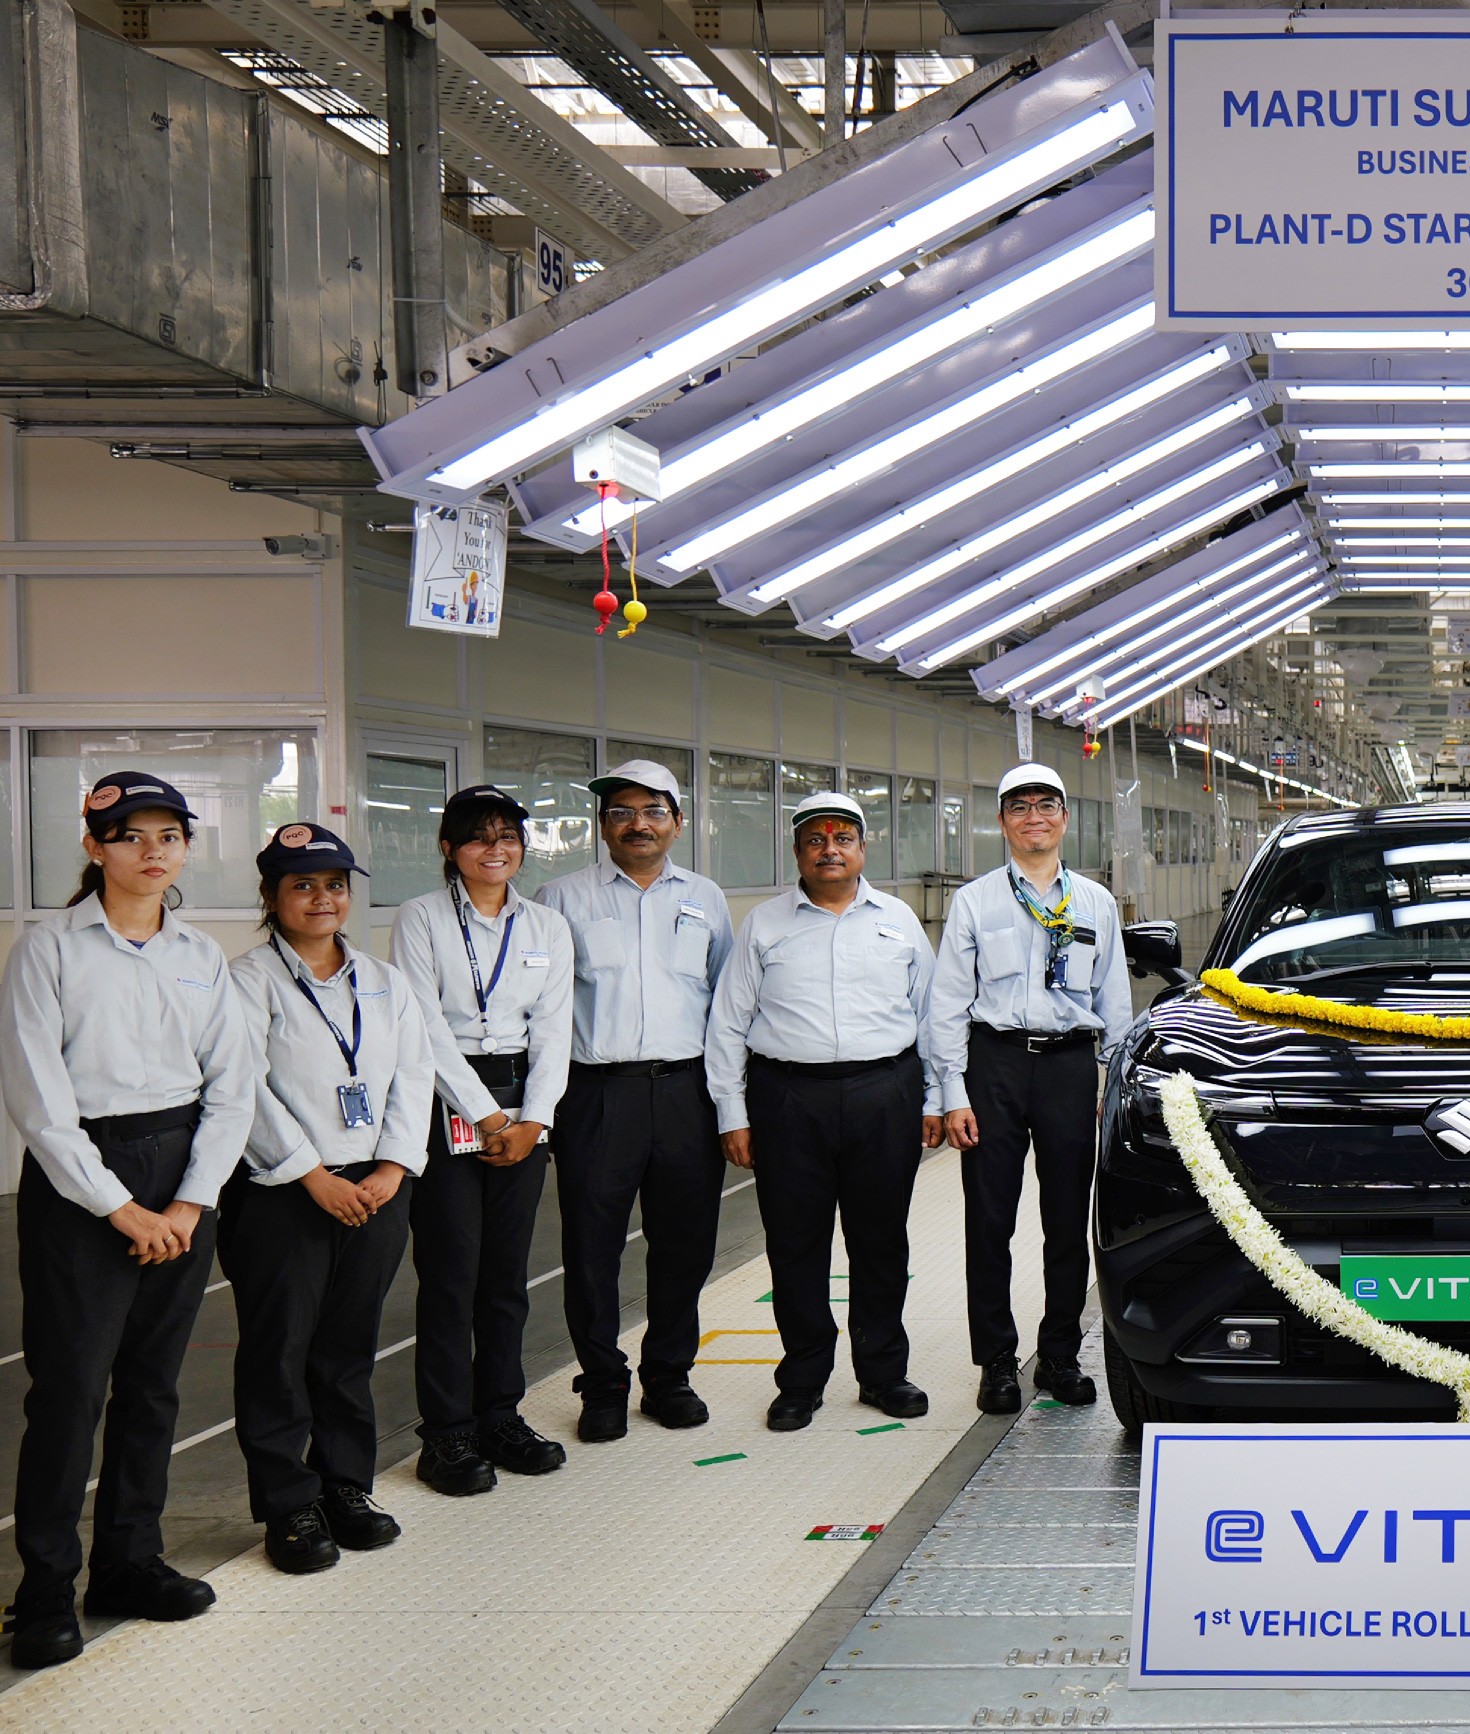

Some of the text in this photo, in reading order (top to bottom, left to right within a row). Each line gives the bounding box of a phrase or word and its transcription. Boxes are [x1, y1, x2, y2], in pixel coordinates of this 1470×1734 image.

[1223, 89, 1400, 129] MARUTI
[1209, 213, 1374, 246] PLANT-D
[541, 242, 562, 292] 95
[464, 532, 480, 547] You
[1193, 1607, 1233, 1638] 1st
[1238, 1608, 1384, 1639] VEHICLE
